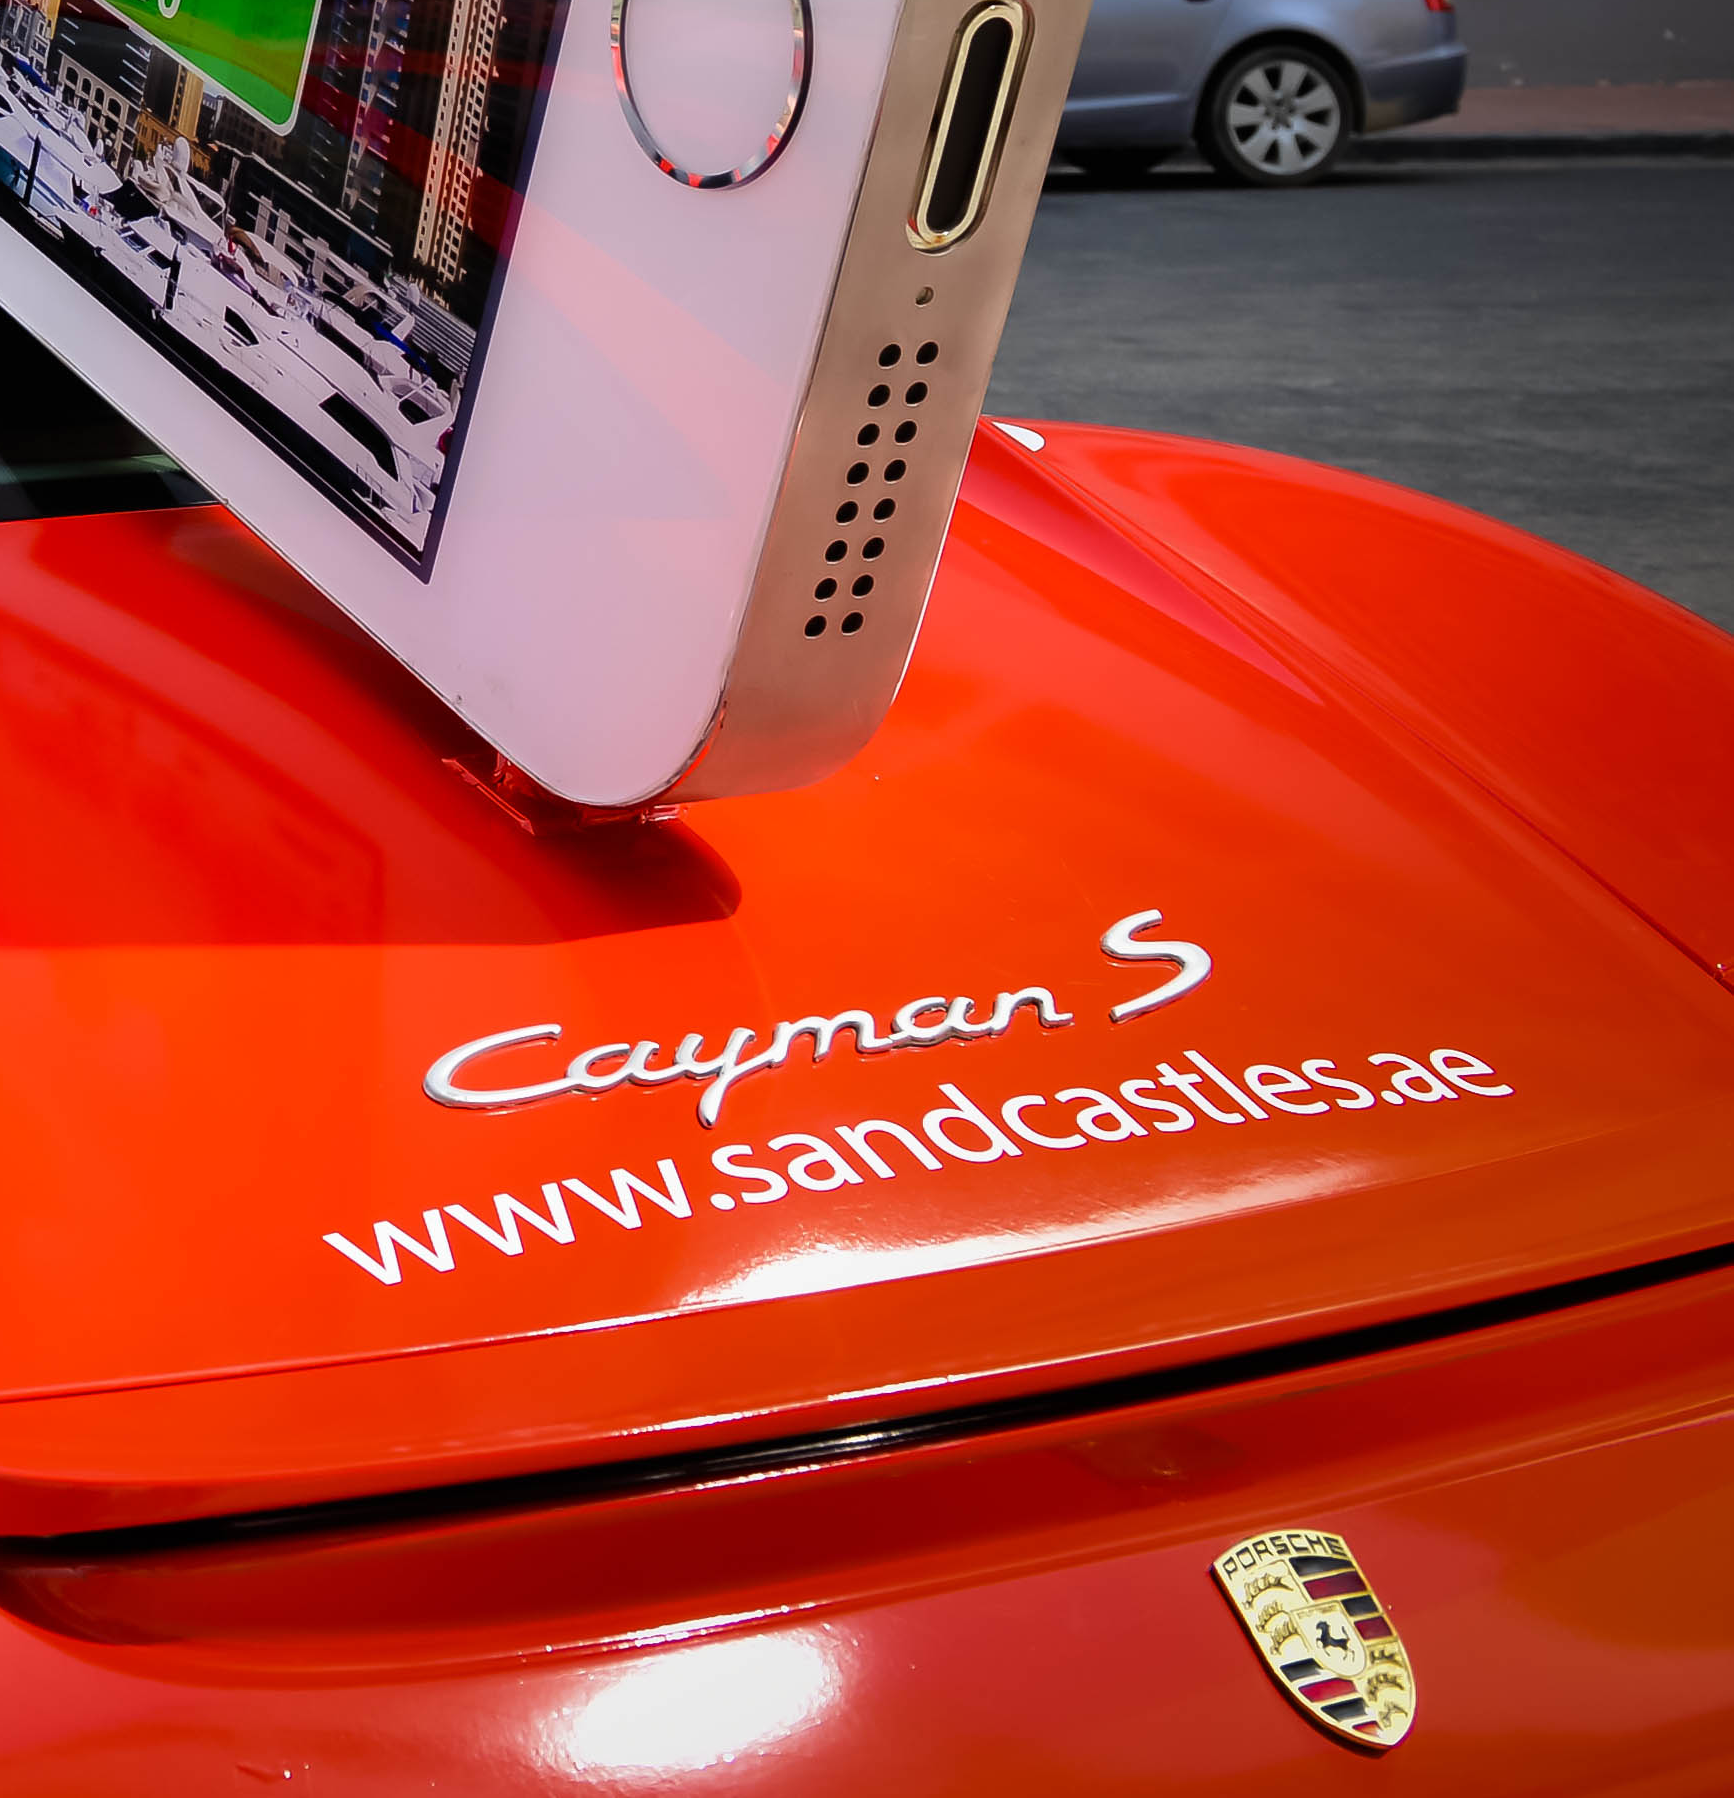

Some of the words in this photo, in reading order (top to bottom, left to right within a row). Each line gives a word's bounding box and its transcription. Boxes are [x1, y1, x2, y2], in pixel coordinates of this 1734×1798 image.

[422, 985, 1073, 1128] Cayman
[1101, 908, 1213, 1024] S
[322, 1046, 1516, 1286] www.sandcastles.ae
[1222, 1533, 1348, 1579] PORSCHE
